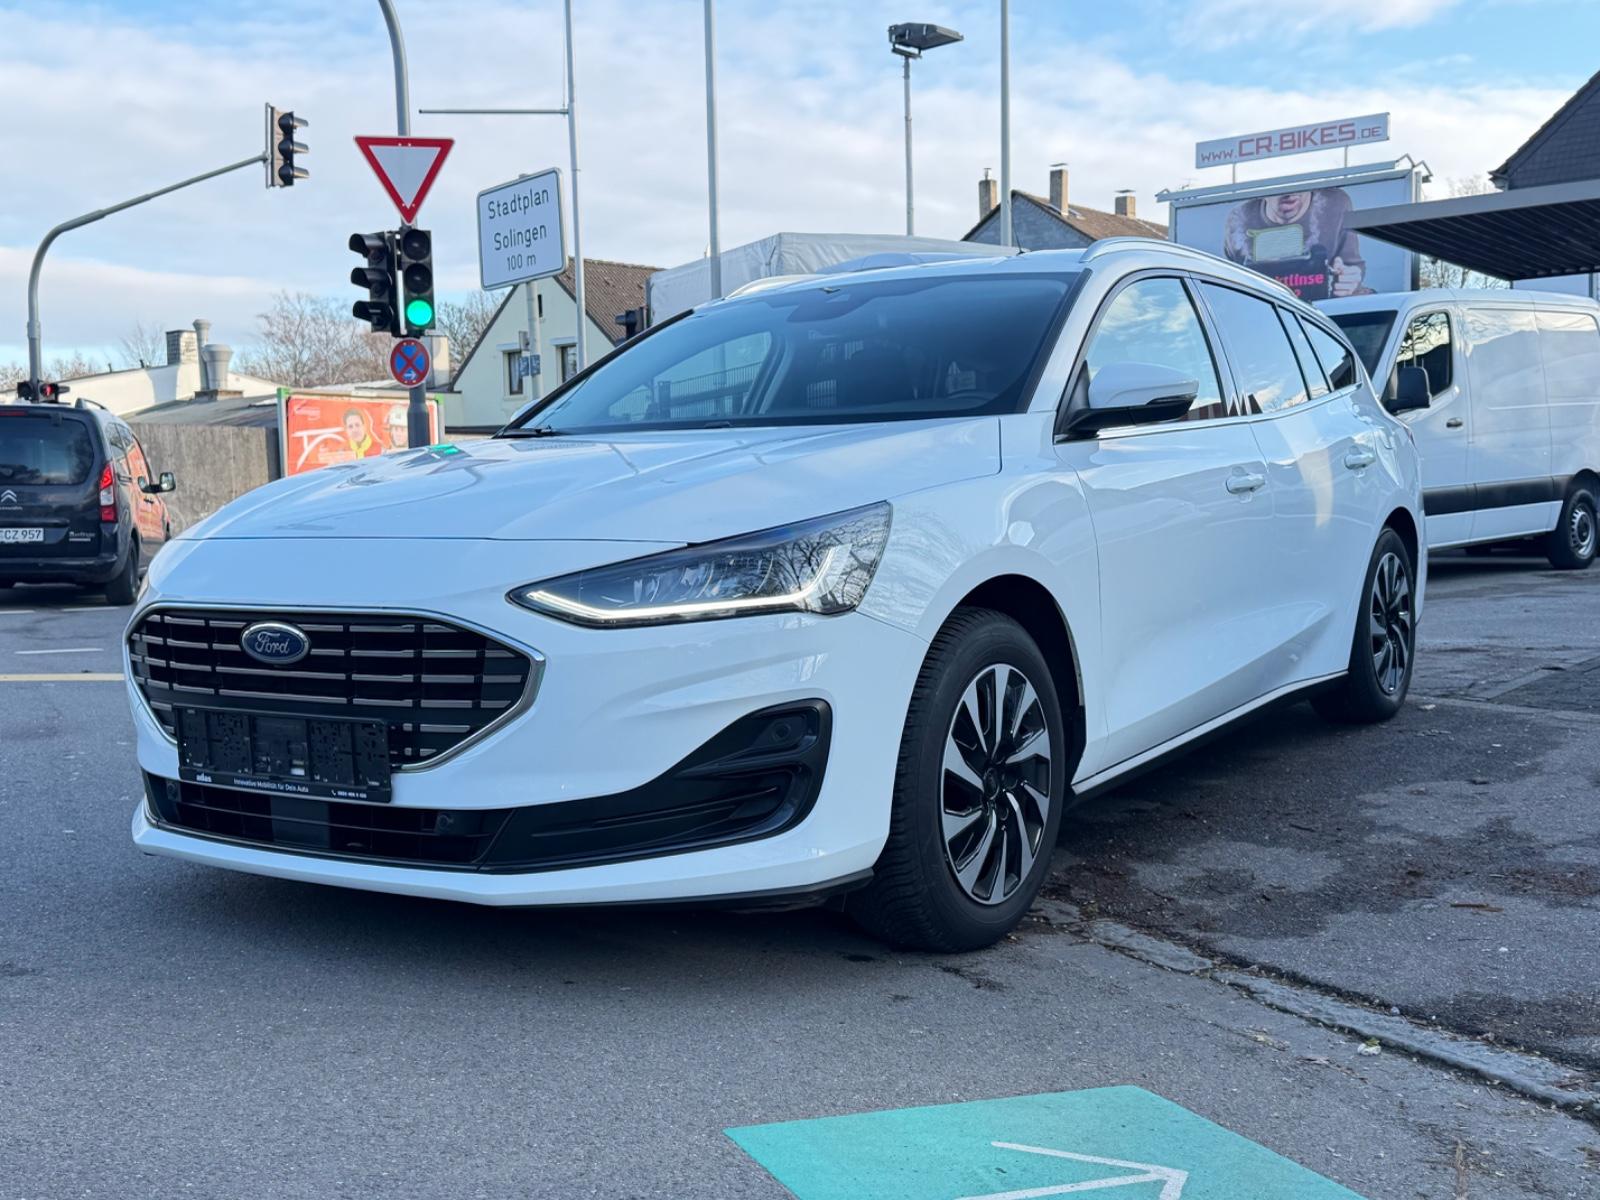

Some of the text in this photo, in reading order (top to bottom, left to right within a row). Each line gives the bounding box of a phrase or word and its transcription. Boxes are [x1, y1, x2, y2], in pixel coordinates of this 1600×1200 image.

[488, 188, 549, 220] Stadtplan
[494, 224, 547, 251] Solingen
[507, 253, 537, 272] 100 m
[21, 529, 42, 540] 957
[255, 631, 290, 654] Ford
